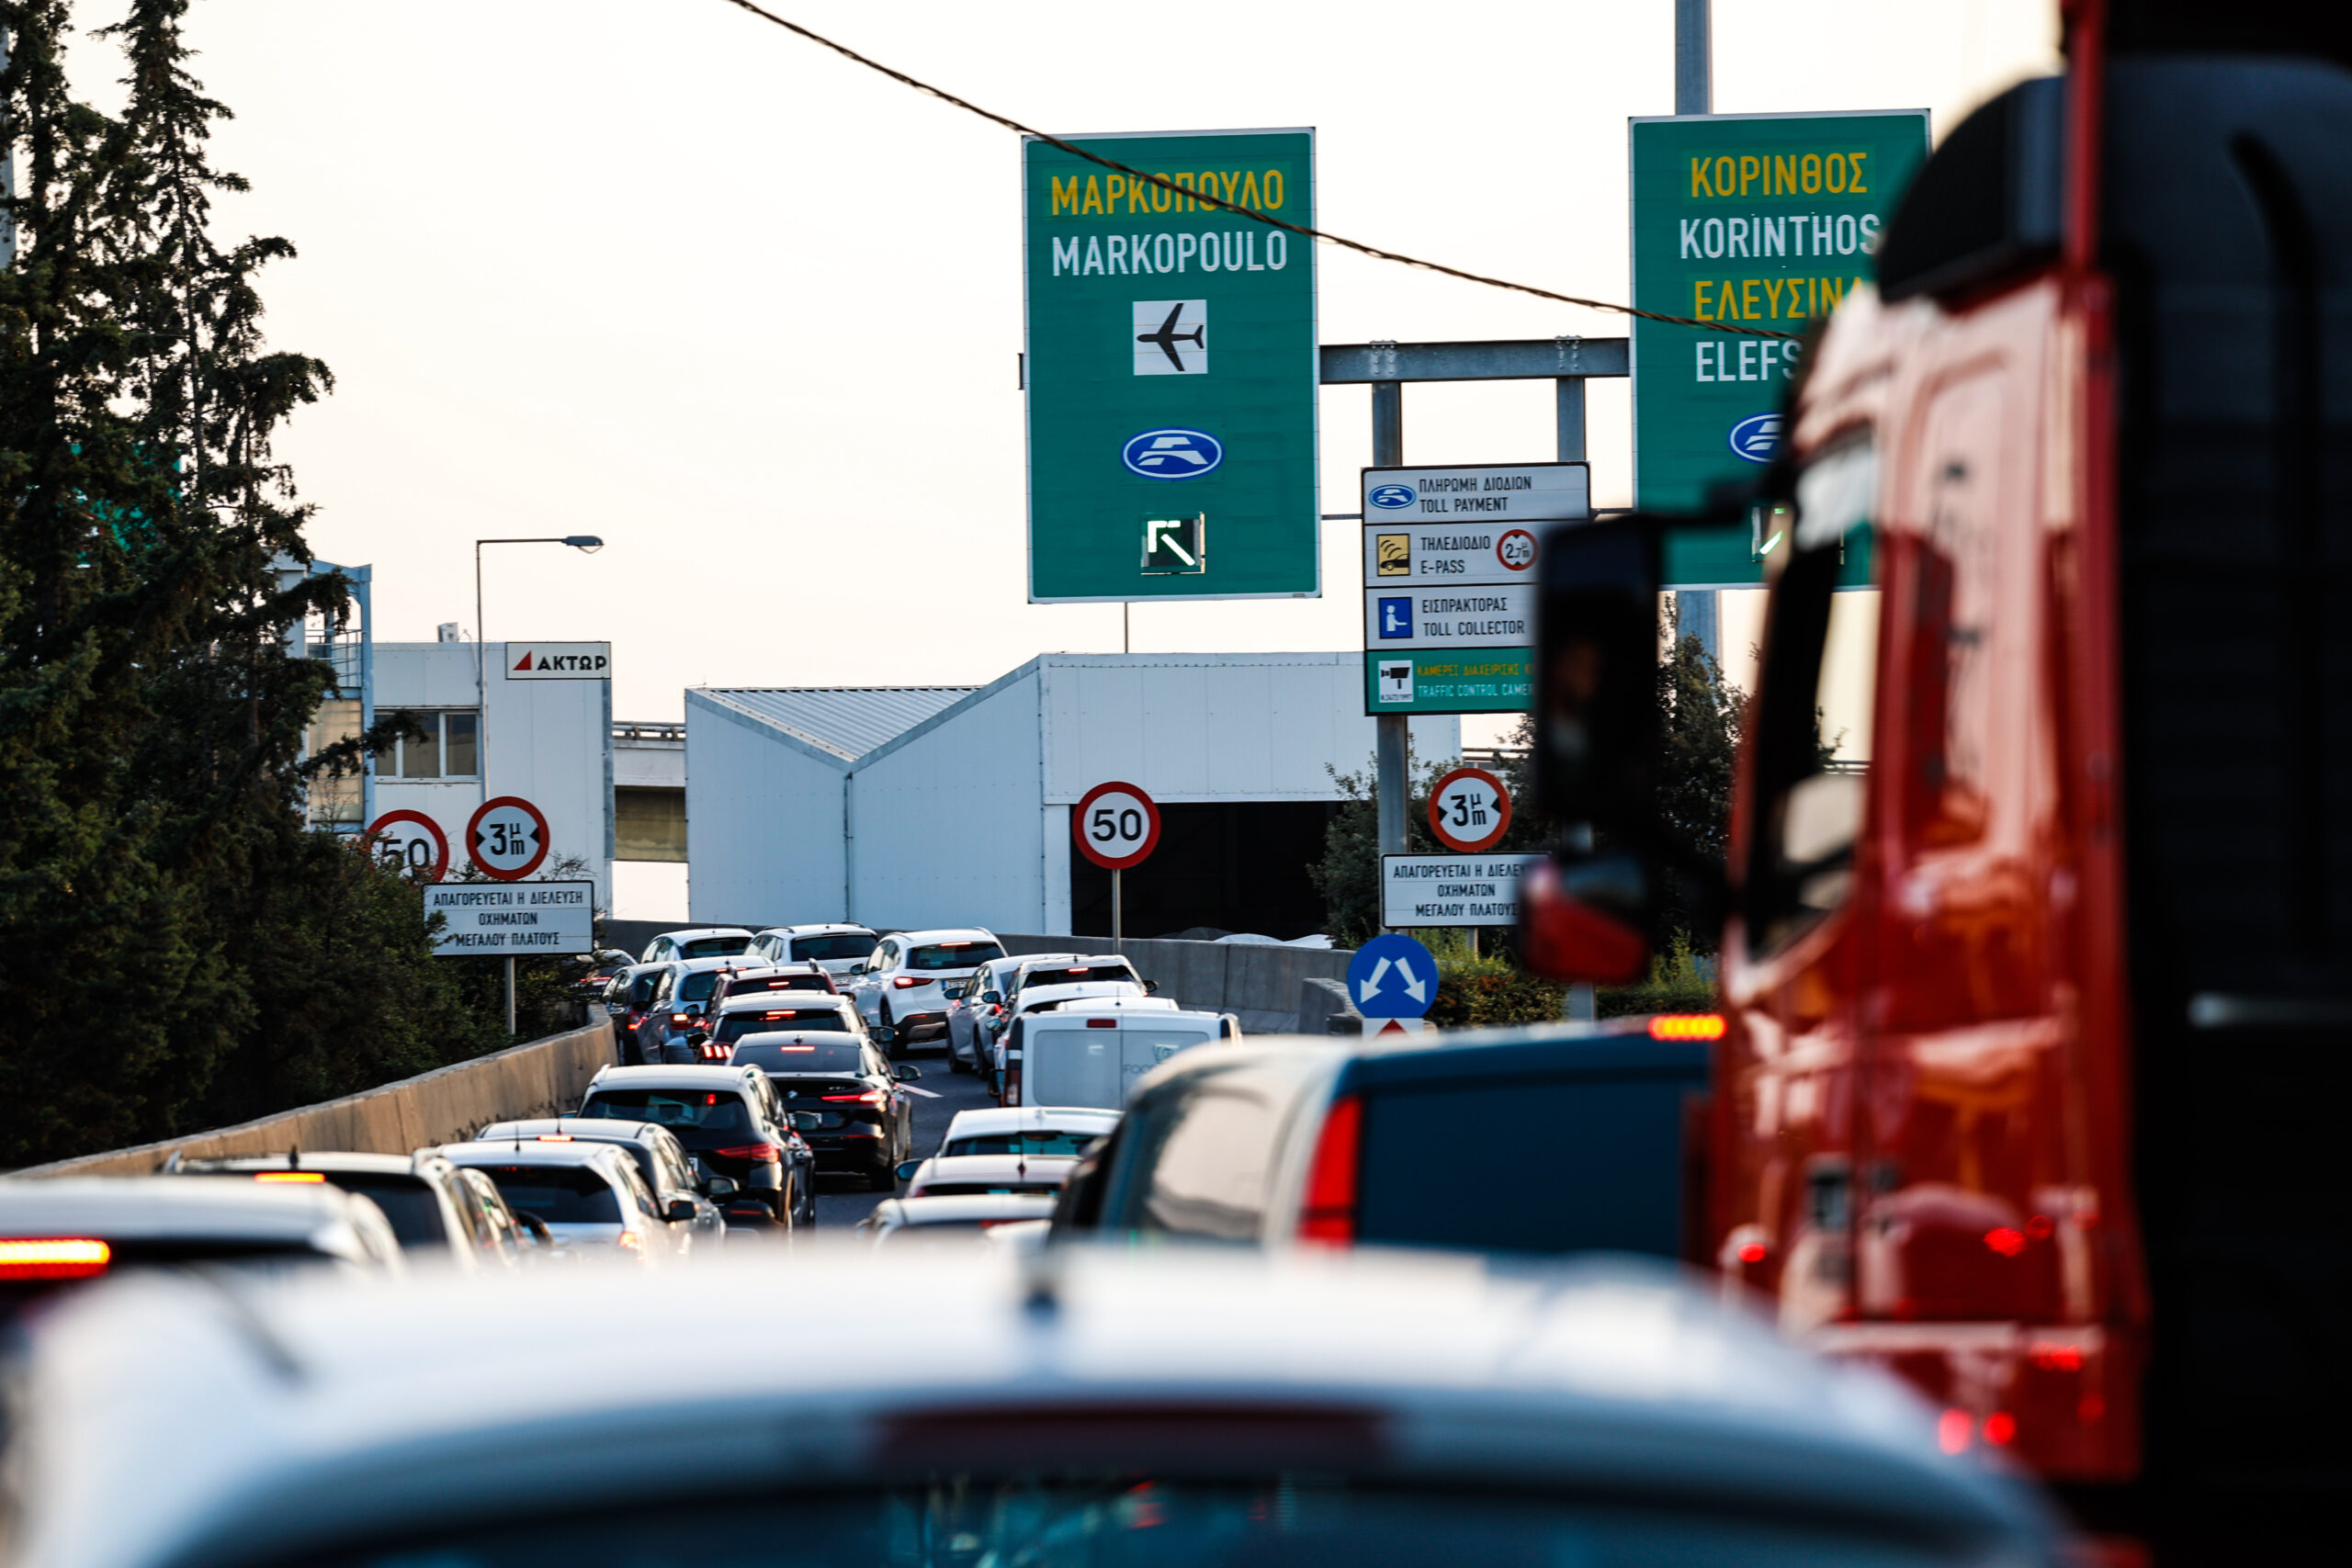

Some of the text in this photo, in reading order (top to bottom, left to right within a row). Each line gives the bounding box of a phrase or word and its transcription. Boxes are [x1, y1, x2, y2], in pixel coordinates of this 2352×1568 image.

[1690, 152, 1868, 197] ΚΟΡΙΝΘΟΣ
[1052, 169, 1284, 216] ΜΑΡΚΟΠΟΥΛΟ
[1679, 214, 1881, 259] KORINTHOS
[1052, 231, 1287, 276] MARKOPOULO
[1696, 339, 1802, 382] ELEFS
[1419, 476, 1532, 492] ΠΛΗΡΩΜΗ ΔΙΟΔΙΩΝ
[1419, 497, 1509, 513] TOLL PAYMENT
[1420, 536, 1491, 551] ΤΗΛΕΔΙΟΔΙΟ
[1420, 559, 1465, 574] E-PASS
[1422, 597, 1508, 614] ΕΙΣΠΡΑΚΤΟΡΑΣ
[1423, 620, 1525, 637] TOLL COLLECTOR
[537, 655, 607, 671] ΑΚΤΩΡ
[1418, 684, 1455, 697] TRAFFIC
[1456, 683, 1498, 696] CONTROL
[1091, 808, 1142, 841] 50
[1393, 864, 1470, 878] ΑΠΑΓΟΡΕΥΕΤΑΙ
[1475, 863, 1483, 876] Η
[433, 891, 583, 906] ΑΠΑΓΟΡΕΥΕΤΑΙ Η ΔΙΕΛΕΥΣΗ
[1437, 884, 1496, 897] ΟΧΗΜΑΤΩΝ
[1415, 903, 1465, 917] ΜΕΓΑΛΟΥ
[478, 912, 538, 926] ΟΧΗΜΑΤΩΝ
[456, 931, 560, 947] ΜΕΓΑΛΟΥ ΠΛΑΤΟΥΣ
